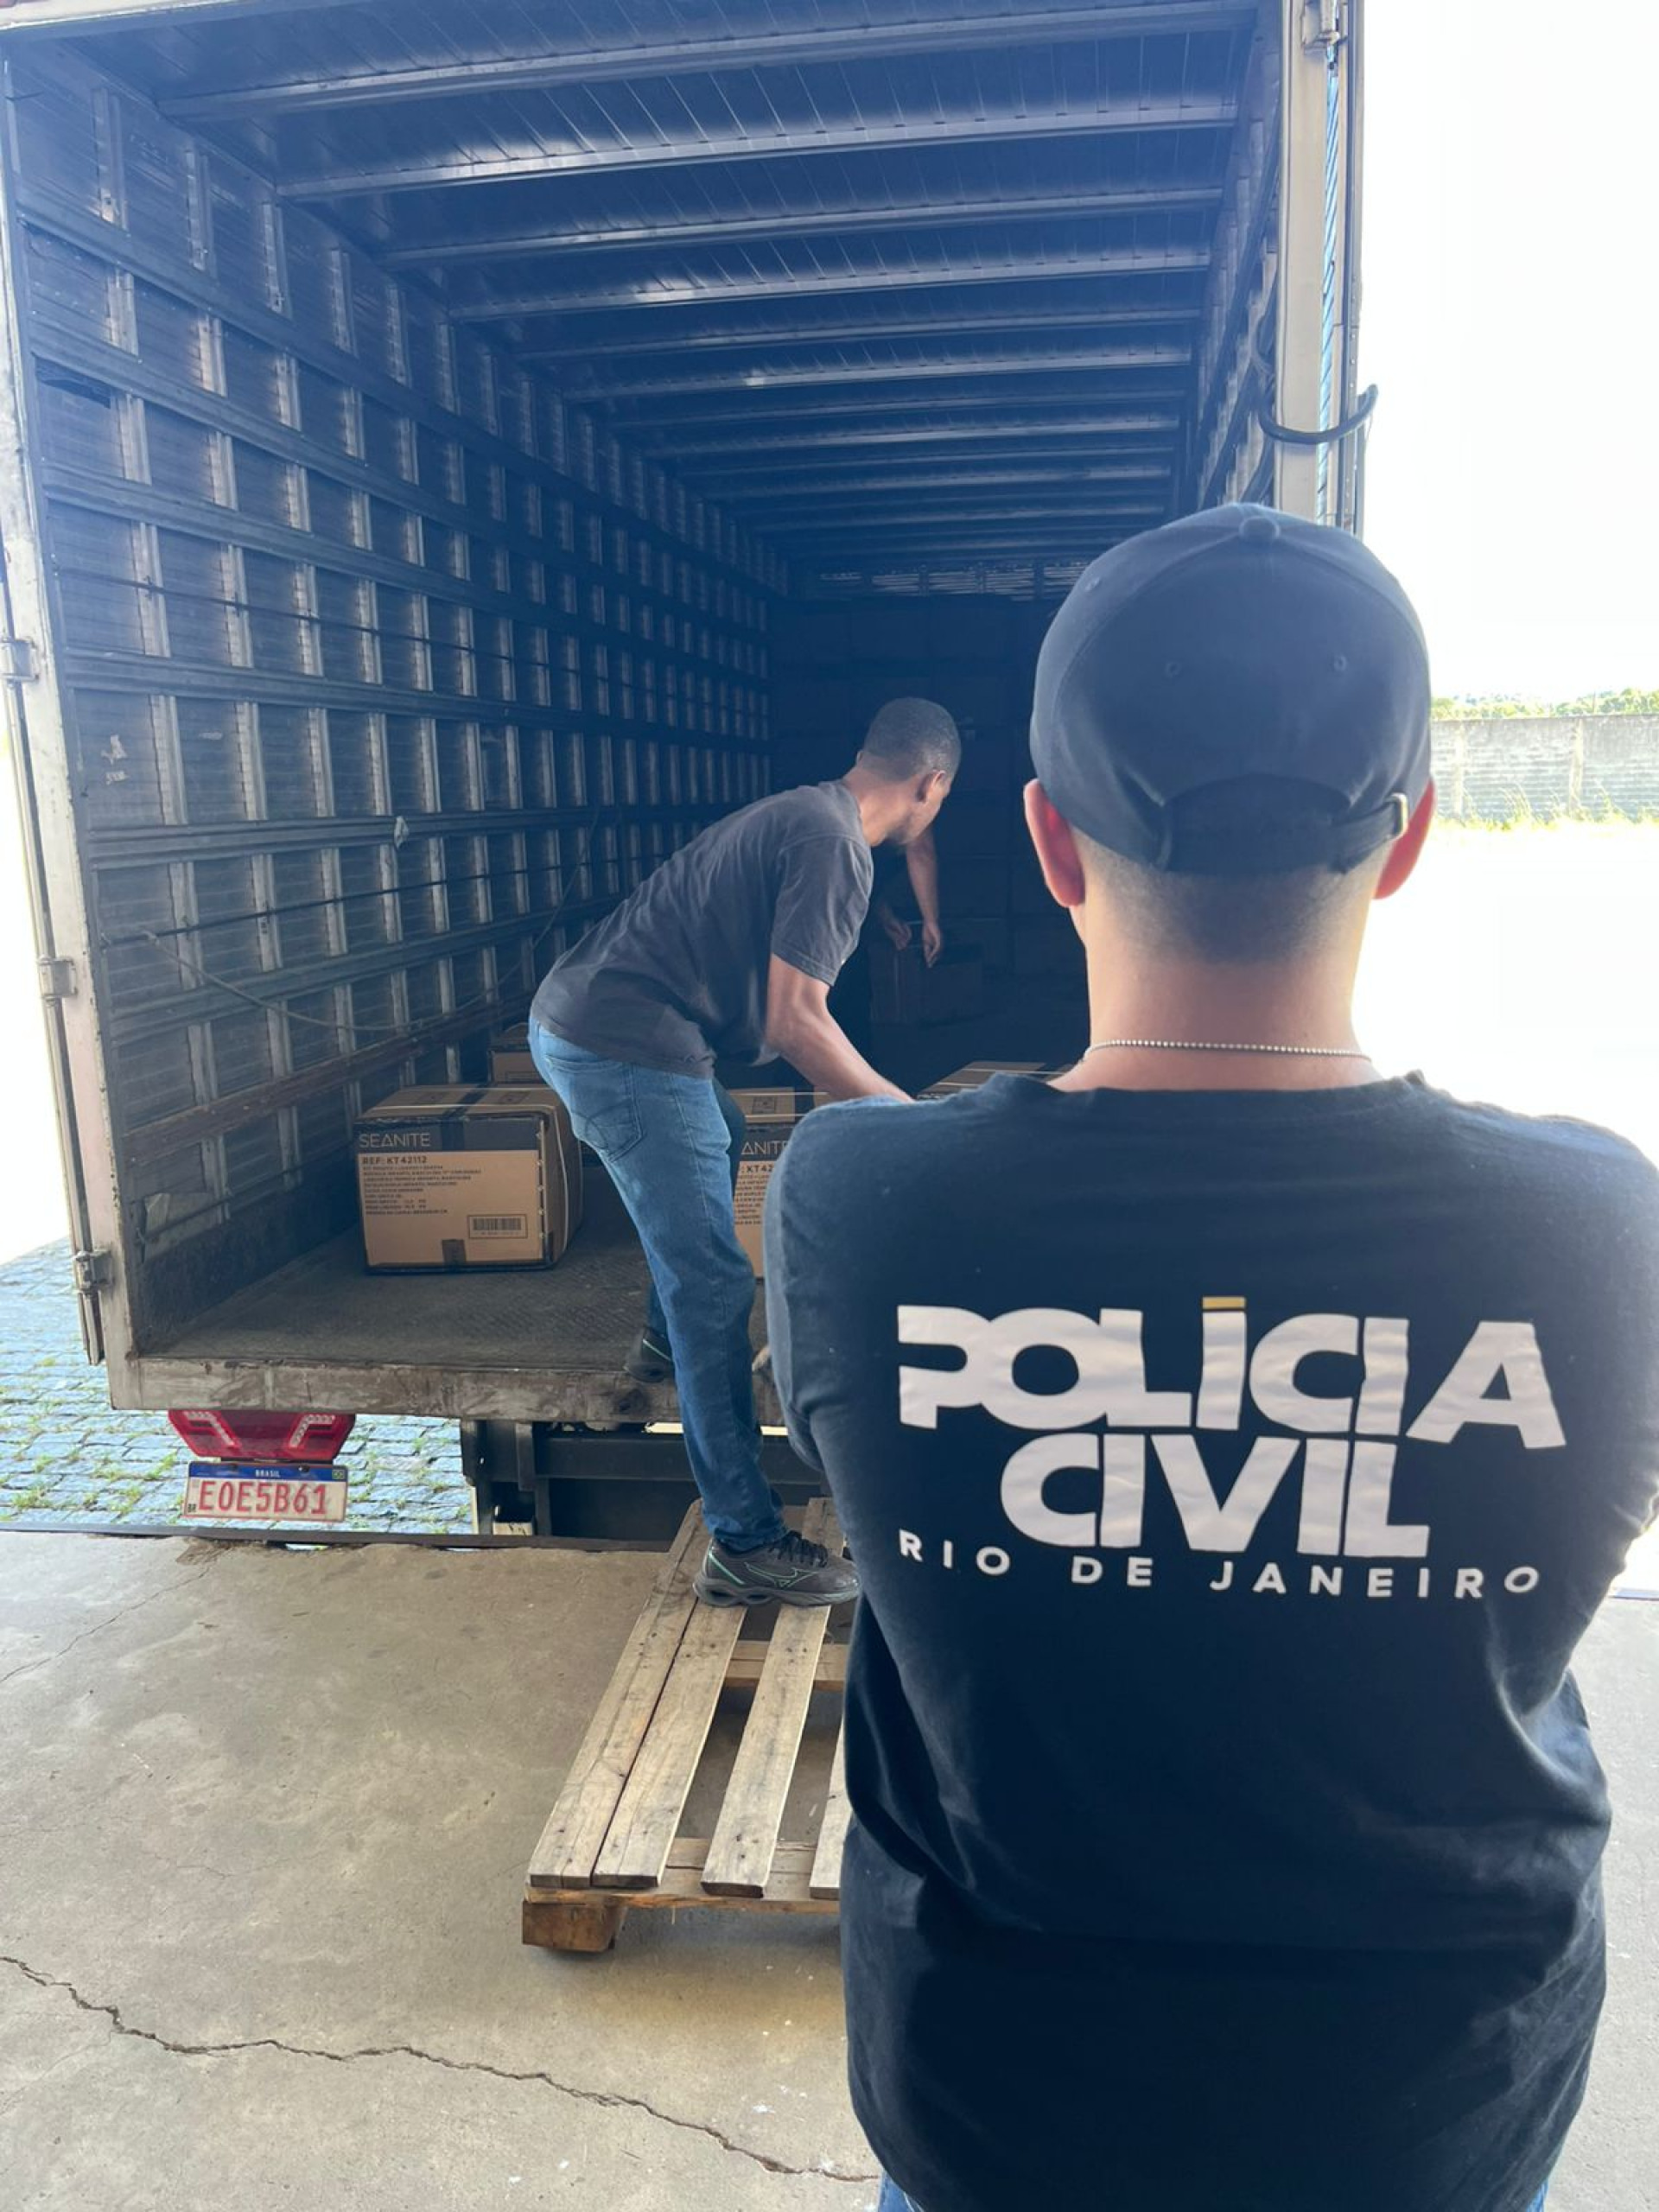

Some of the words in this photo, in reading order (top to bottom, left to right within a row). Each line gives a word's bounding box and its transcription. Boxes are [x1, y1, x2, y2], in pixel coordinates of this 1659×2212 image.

[359, 1133, 431, 1148] SEANITE
[741, 1141, 789, 1155] ANIT
[255, 1469, 281, 1478] BRASIL
[1001, 1433, 1430, 1557] CIVIL
[899, 1529, 1010, 1575] RIO
[1071, 1556, 1154, 1586] DE
[1210, 1561, 1540, 1599] JANEIRO
